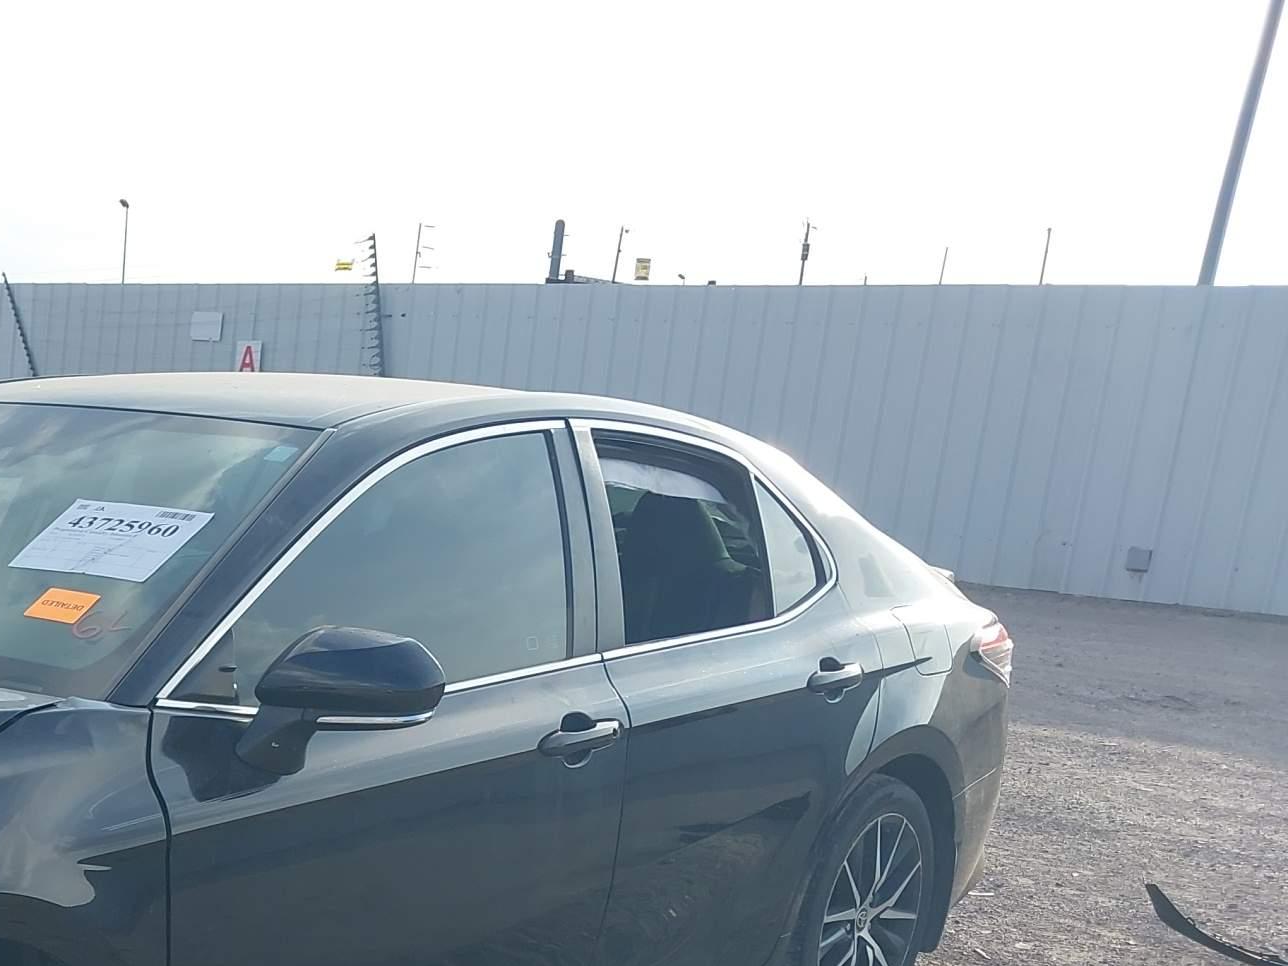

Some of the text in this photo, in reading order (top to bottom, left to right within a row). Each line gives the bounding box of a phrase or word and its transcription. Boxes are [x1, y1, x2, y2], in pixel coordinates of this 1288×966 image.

[239, 345, 255, 372] A
[67, 515, 181, 538] 43725960
[41, 599, 85, 612] DETAILED
